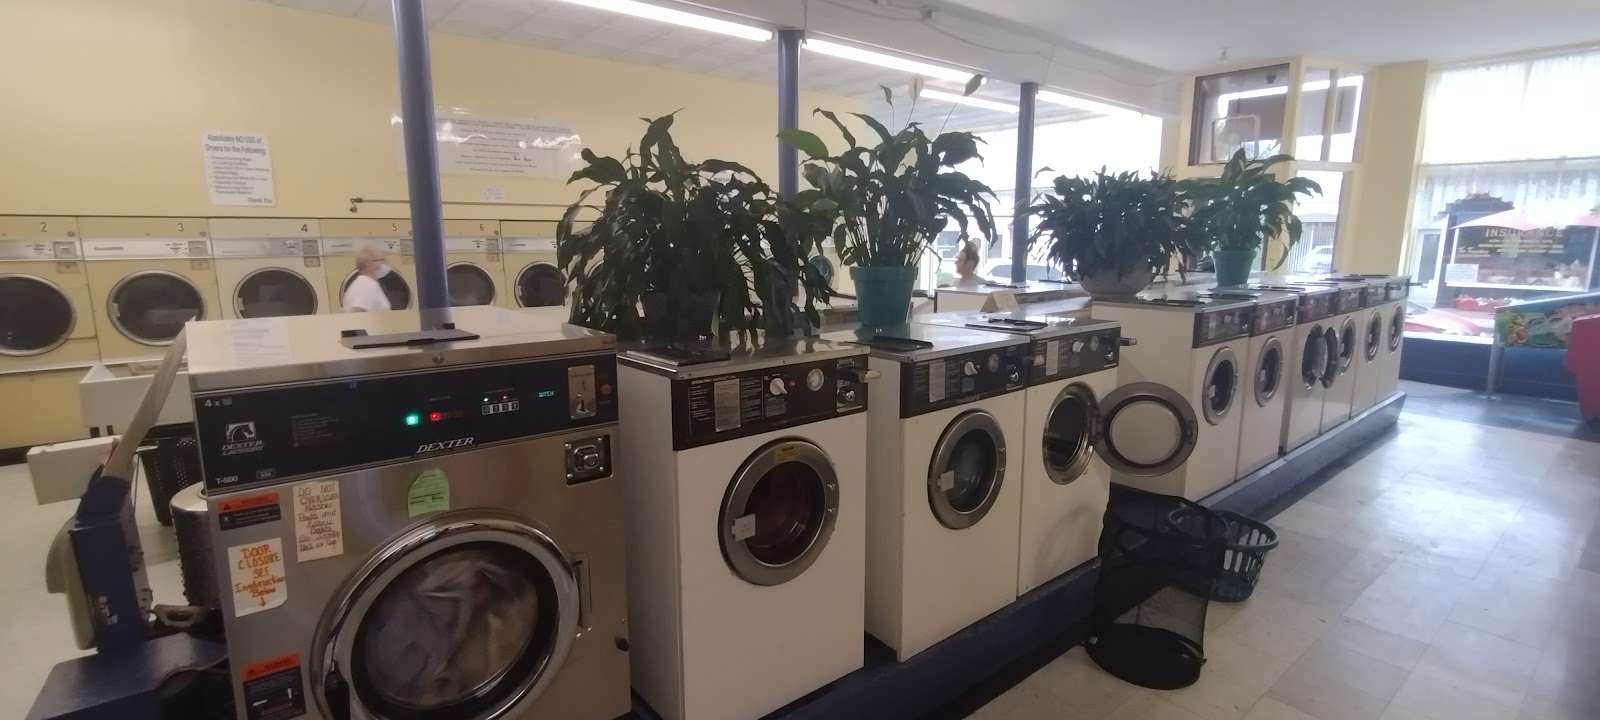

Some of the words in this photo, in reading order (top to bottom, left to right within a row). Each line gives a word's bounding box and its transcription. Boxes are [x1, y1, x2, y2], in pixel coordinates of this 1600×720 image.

[236, 135, 244, 143] NO
[245, 136, 256, 144] USE
[205, 144, 223, 153] Dryers
[40, 221, 48, 232] 2
[178, 222, 184, 232] 3
[301, 224, 308, 232] 4
[392, 223, 397, 231] 5
[480, 223, 484, 231] 6
[1485, 228, 1563, 237] INSURANCE
[205, 399, 212, 407] 4
[222, 440, 263, 450] DEXTER
[416, 436, 474, 454] DEXTER
[216, 475, 238, 484] T-600
[298, 487, 311, 497] DO
[320, 484, 335, 493] NOT
[241, 544, 273, 559] DOOR
[238, 552, 280, 570] CLOSURE
[253, 566, 269, 579] SEE
